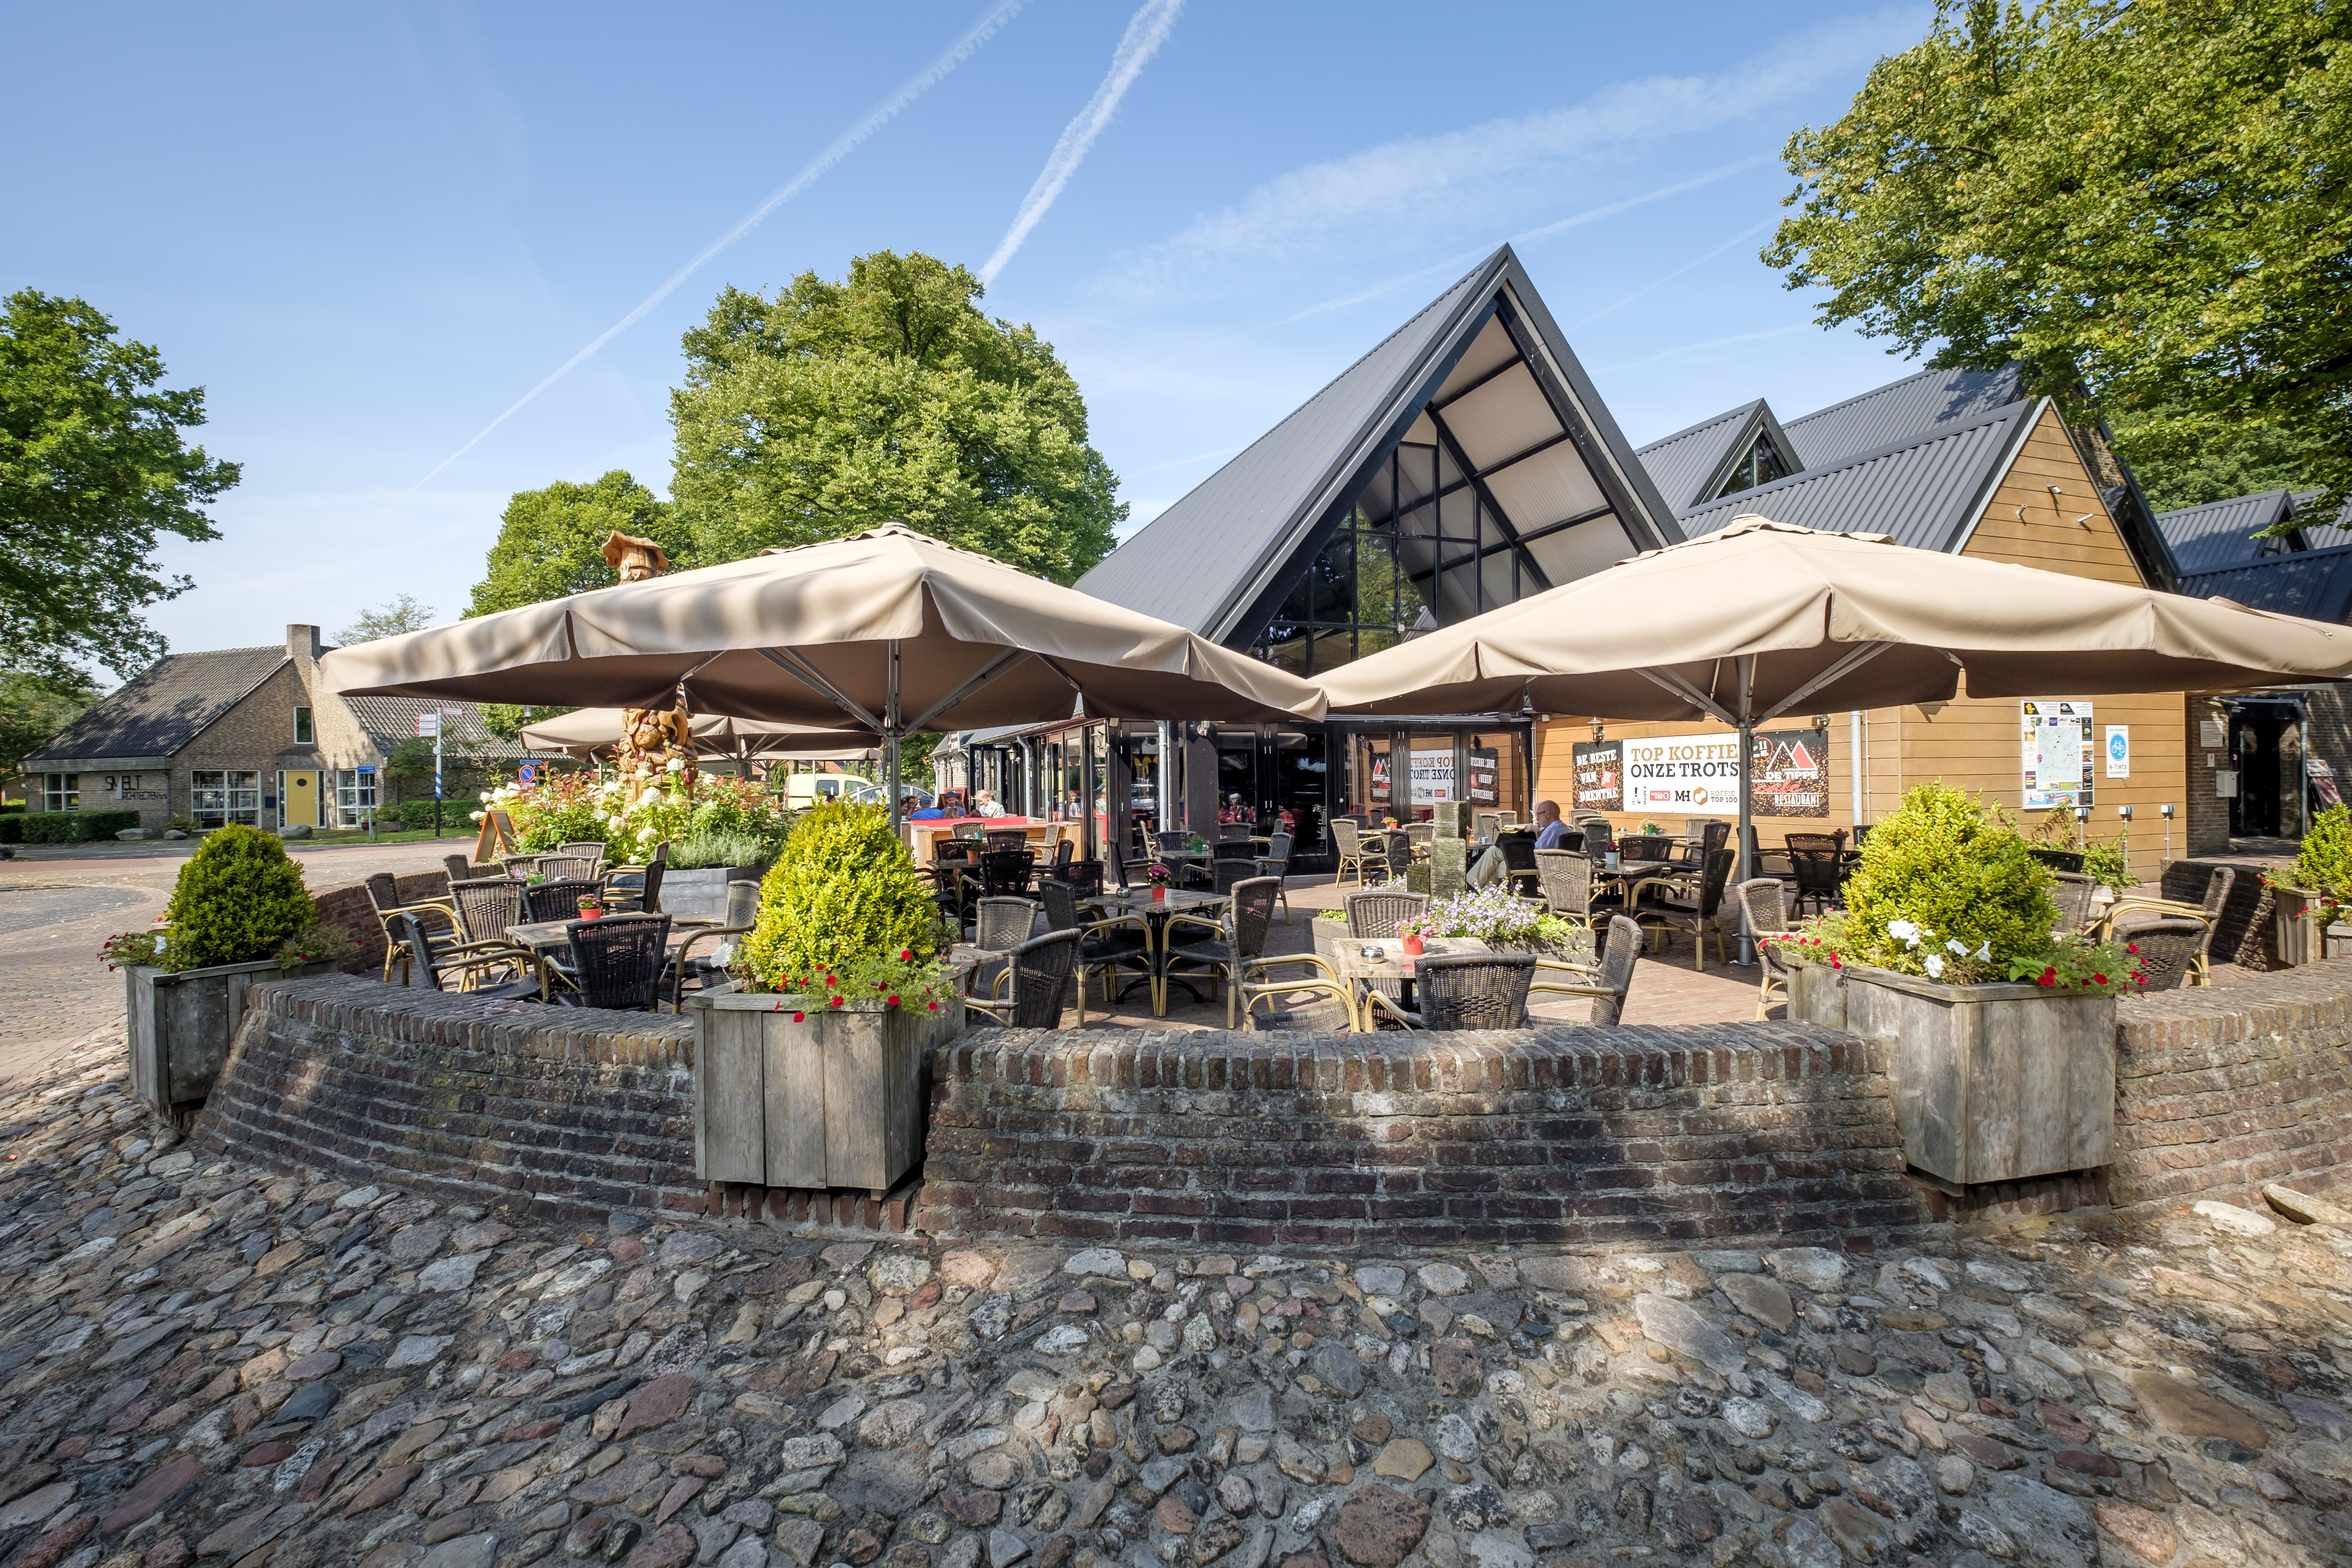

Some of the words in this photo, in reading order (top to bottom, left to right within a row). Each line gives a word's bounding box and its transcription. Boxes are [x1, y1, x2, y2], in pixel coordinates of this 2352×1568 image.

[1759, 740, 1768, 750] 11
[1576, 755, 1588, 766] DE
[1590, 750, 1617, 764] BESTE
[1632, 748, 1663, 761] TOP
[1668, 744, 1737, 760] KOFFIE
[1631, 764, 1675, 777] ONZE
[1679, 762, 1739, 777] TROTS
[1766, 771, 1782, 780] DE
[1784, 771, 1818, 779] TIPPE
[1579, 771, 1597, 784] VAN
[1579, 787, 1618, 802] DRENTHE
[1675, 790, 1690, 801] MH
[1774, 794, 1819, 805] RESTAURANT
